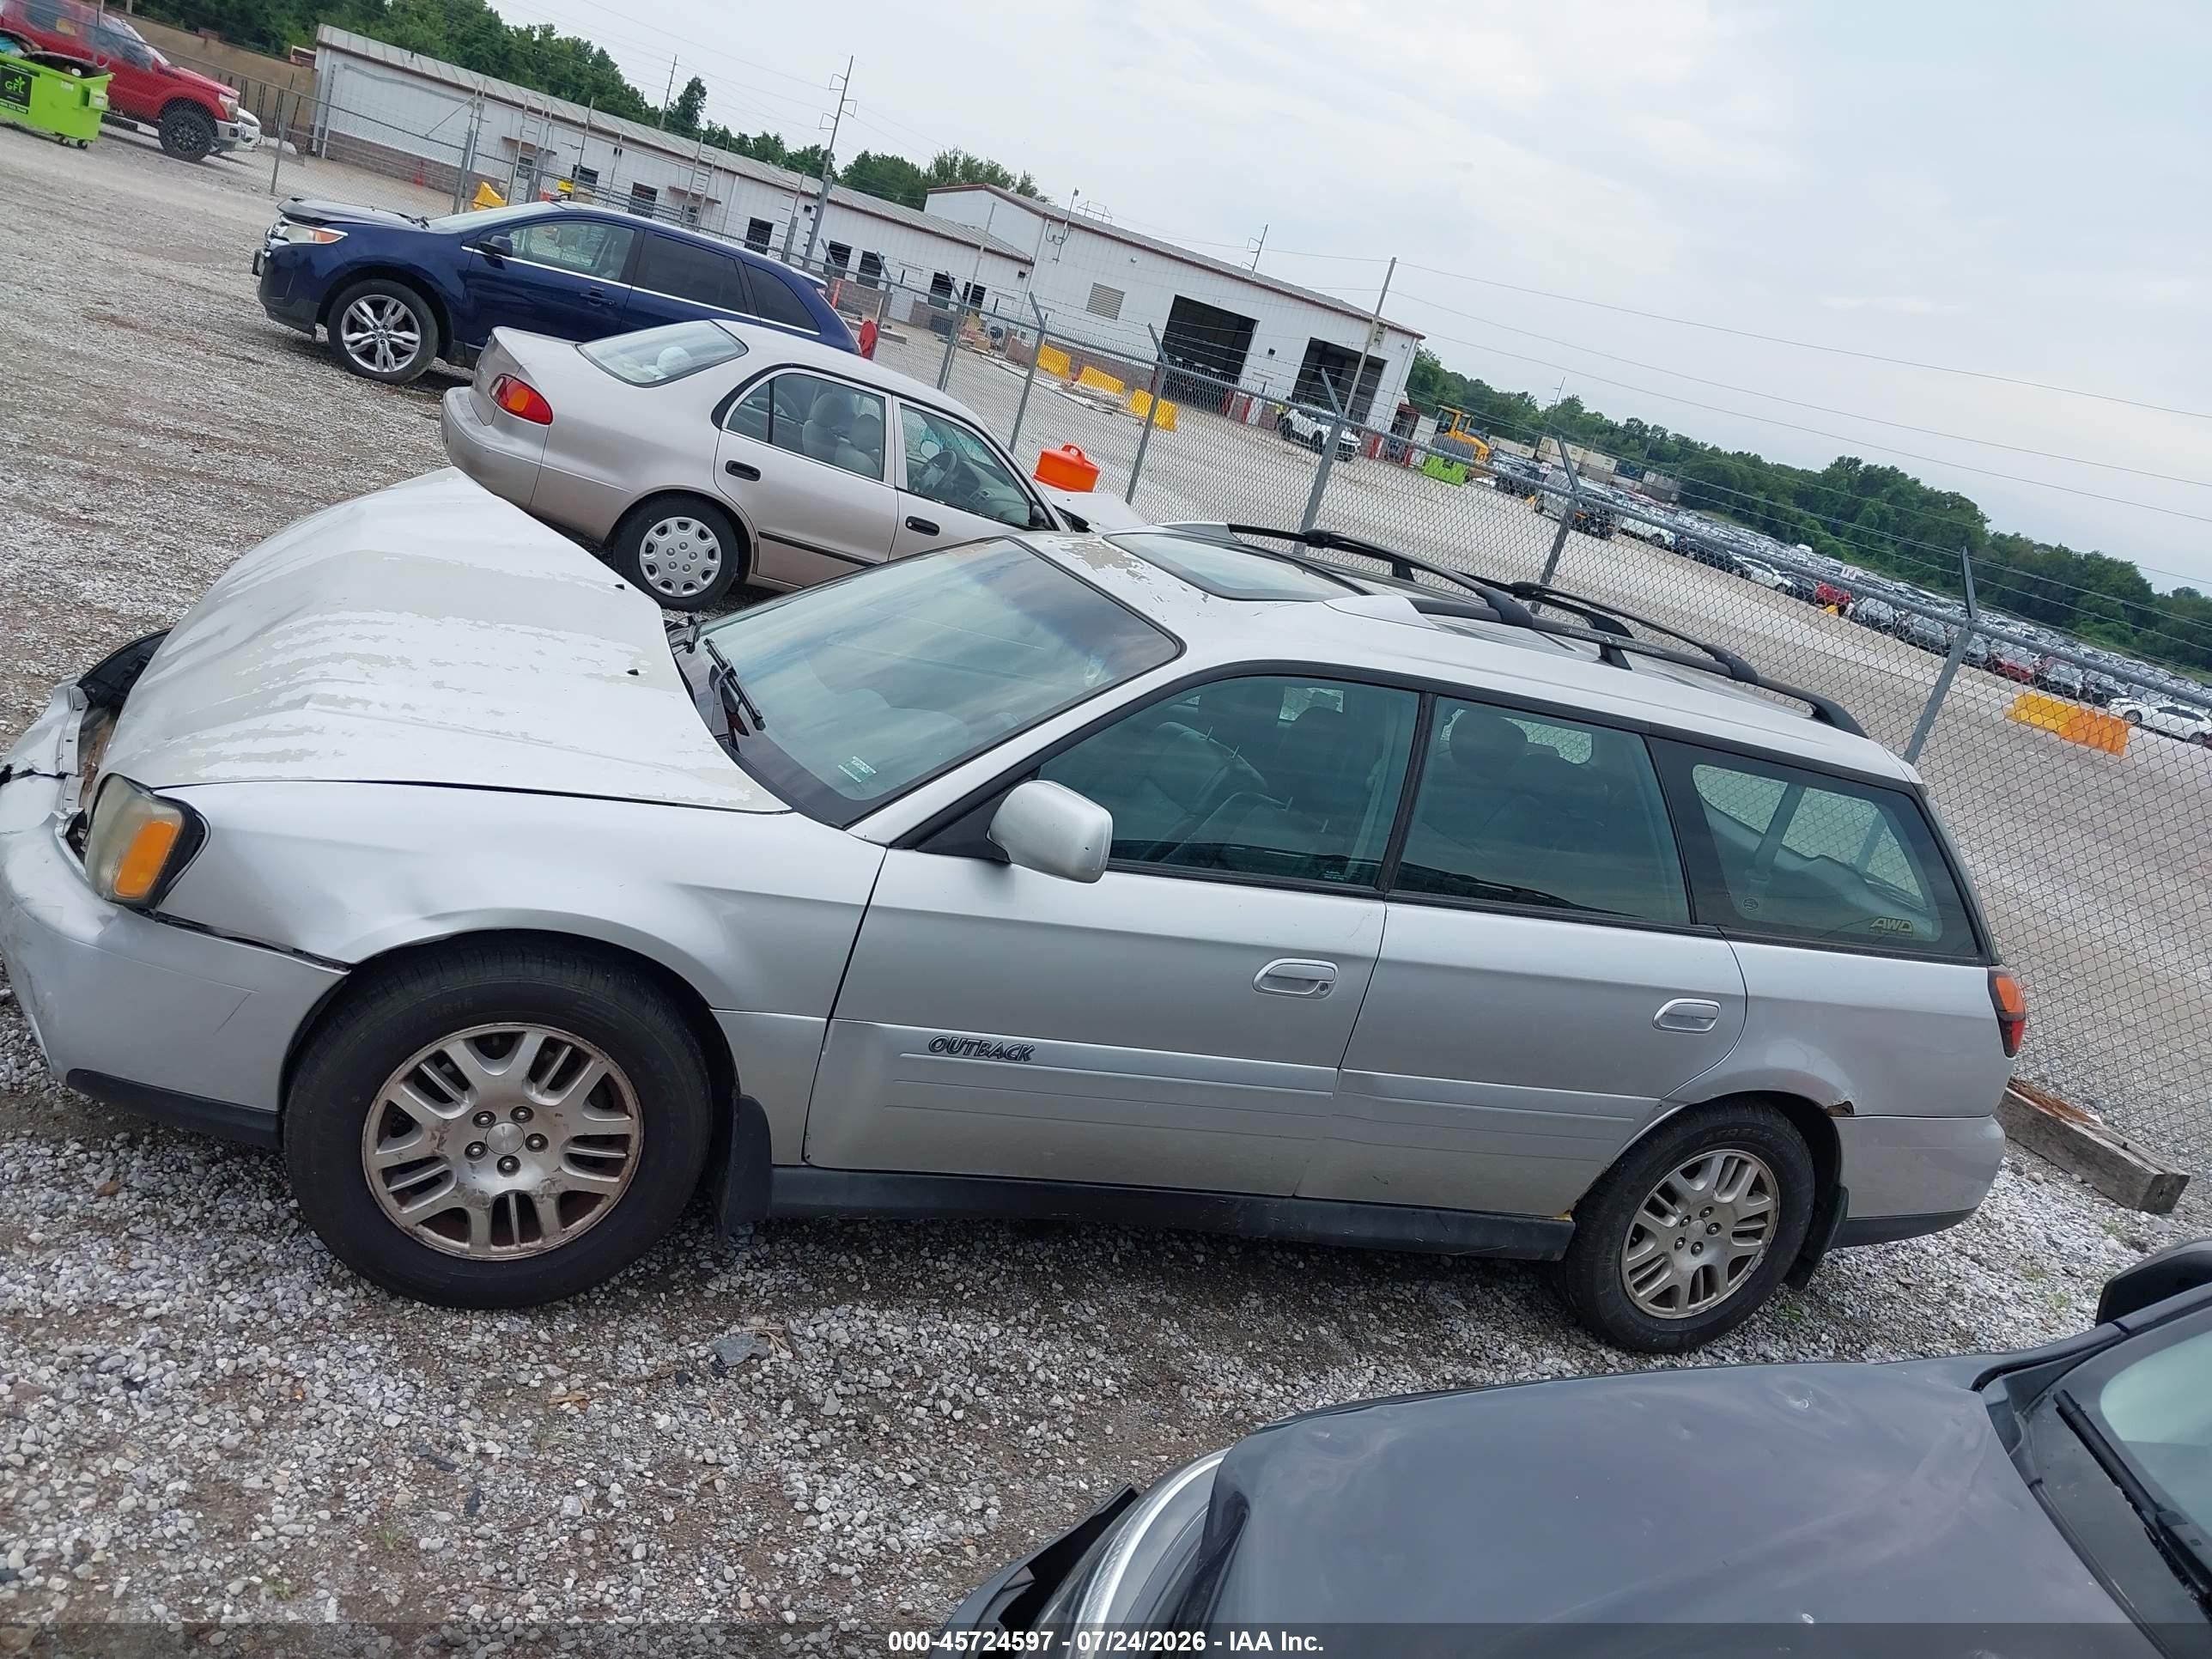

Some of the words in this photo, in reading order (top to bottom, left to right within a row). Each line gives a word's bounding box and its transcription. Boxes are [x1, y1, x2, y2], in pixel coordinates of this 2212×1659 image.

[5, 76, 25, 94] GFL
[1870, 917, 1913, 932] AWD
[928, 1036, 1036, 1061] OUTBACK
